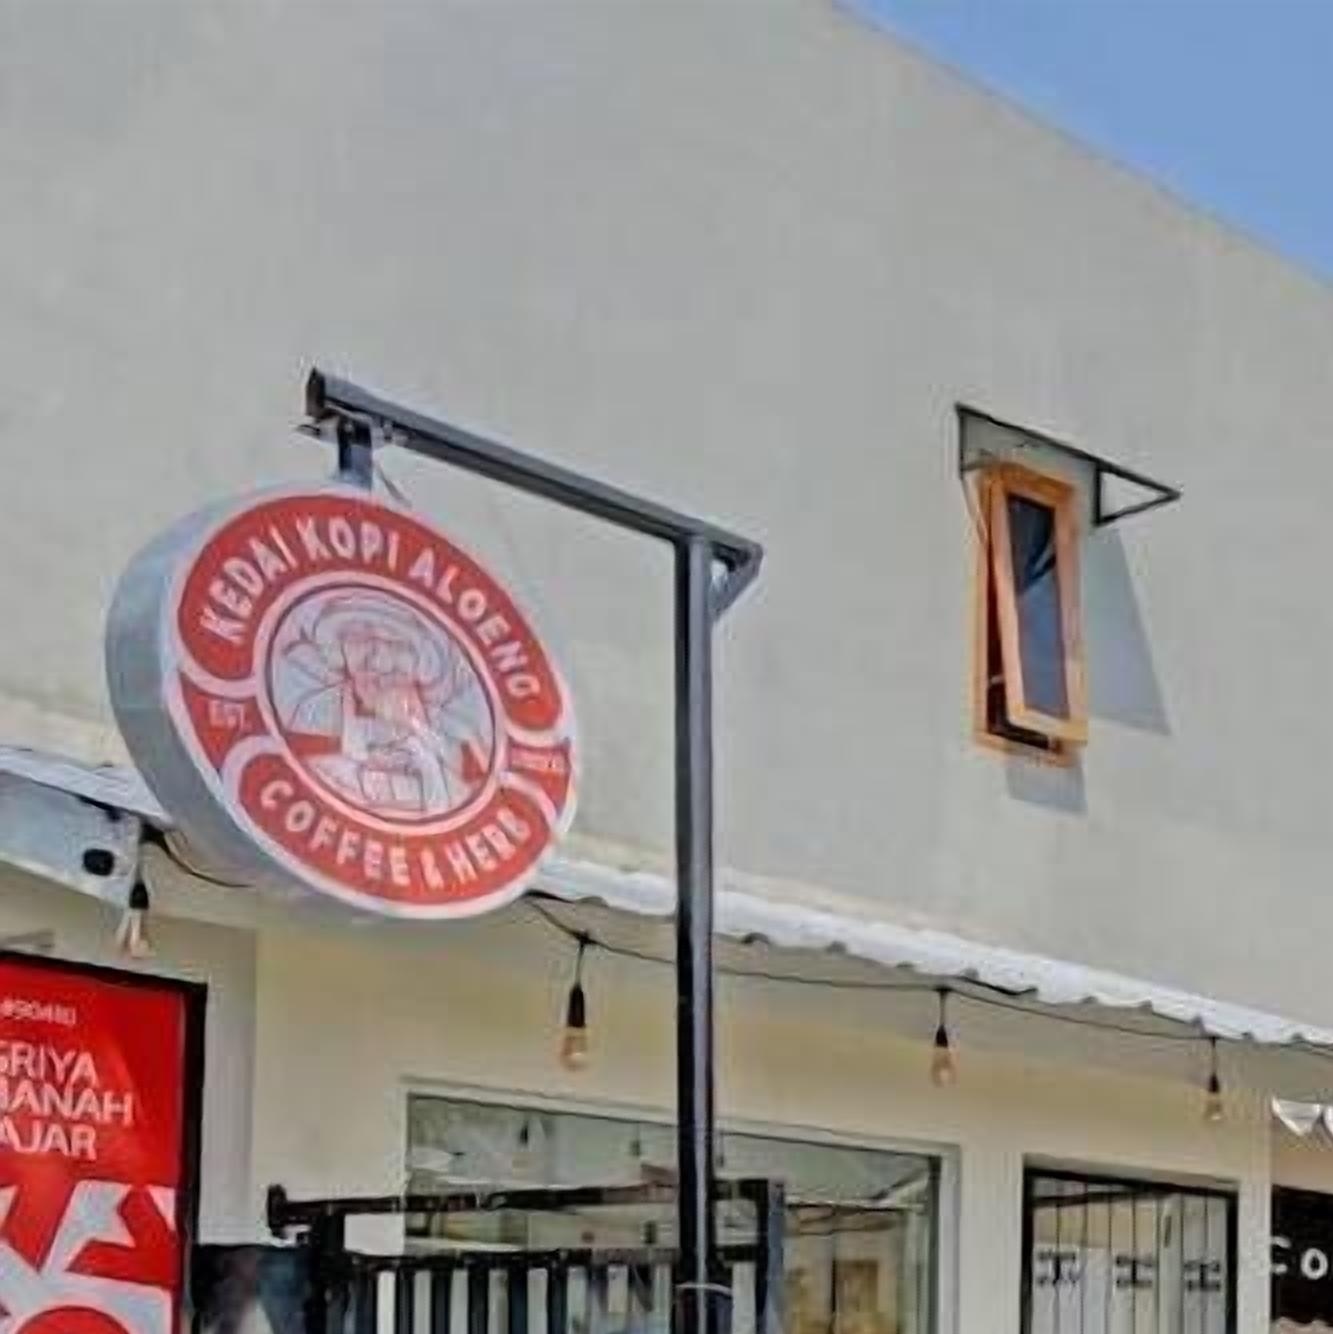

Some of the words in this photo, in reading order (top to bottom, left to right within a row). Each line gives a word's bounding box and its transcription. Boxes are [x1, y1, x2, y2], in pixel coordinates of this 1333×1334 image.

[200, 524, 299, 647] KEDAI
[296, 515, 399, 573] KOPI
[260, 780, 411, 889] COFFEE
[421, 847, 444, 890] &
[443, 806, 532, 885] HERB
[0, 1074, 135, 1127] ANAH
